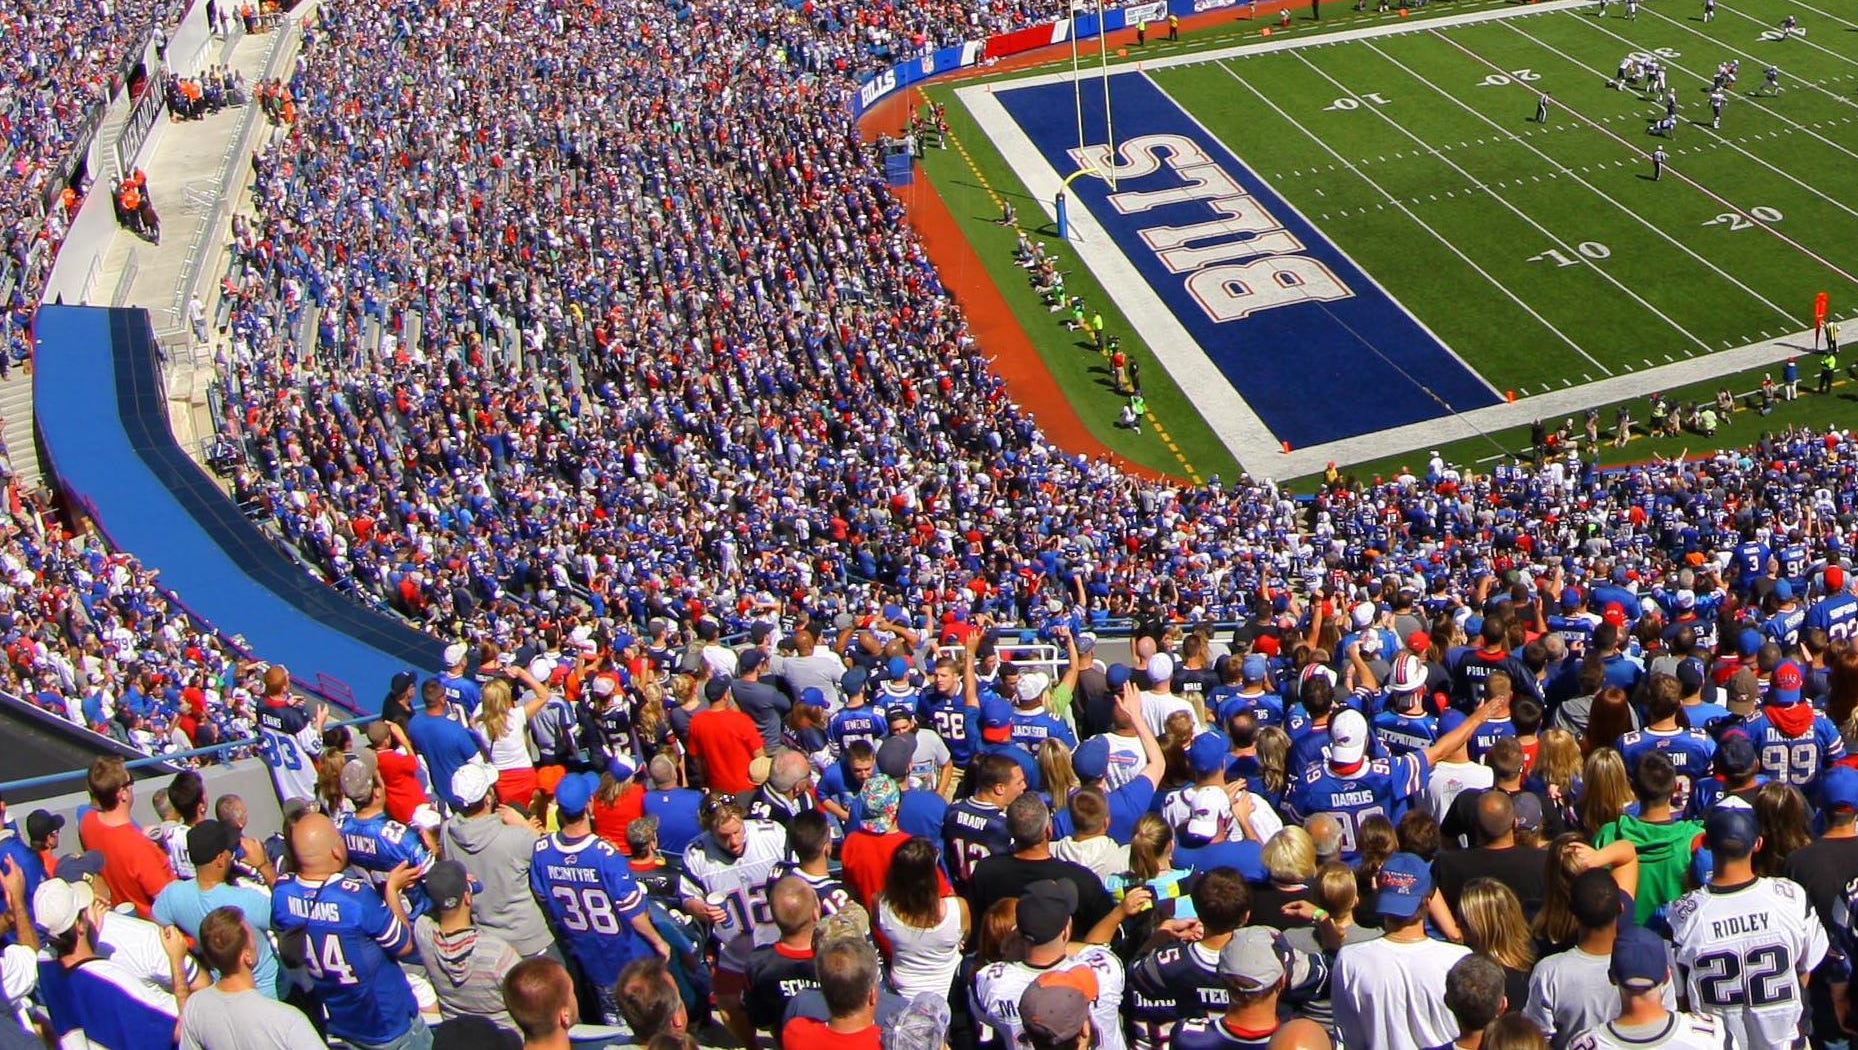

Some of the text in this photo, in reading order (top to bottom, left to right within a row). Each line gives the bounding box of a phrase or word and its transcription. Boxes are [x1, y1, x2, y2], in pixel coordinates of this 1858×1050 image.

[861, 68, 896, 109] BILLS
[1066, 133, 1358, 324] BILLS
[1712, 205, 1785, 232] 20
[1541, 240, 1612, 268] 10
[1749, 555, 1759, 572] 3
[844, 718, 872, 731] OWENS
[933, 711, 967, 740] 28
[1012, 723, 1048, 739] JACKSON
[1761, 742, 1818, 785] 99
[1330, 789, 1375, 809] DAREUS
[956, 810, 989, 832] BRADY
[346, 833, 377, 855] LYNCH
[547, 864, 602, 884] MCINTYRE
[550, 884, 621, 936] 38
[1711, 911, 1769, 940] RIDLEY
[1695, 944, 1796, 1008] 22
